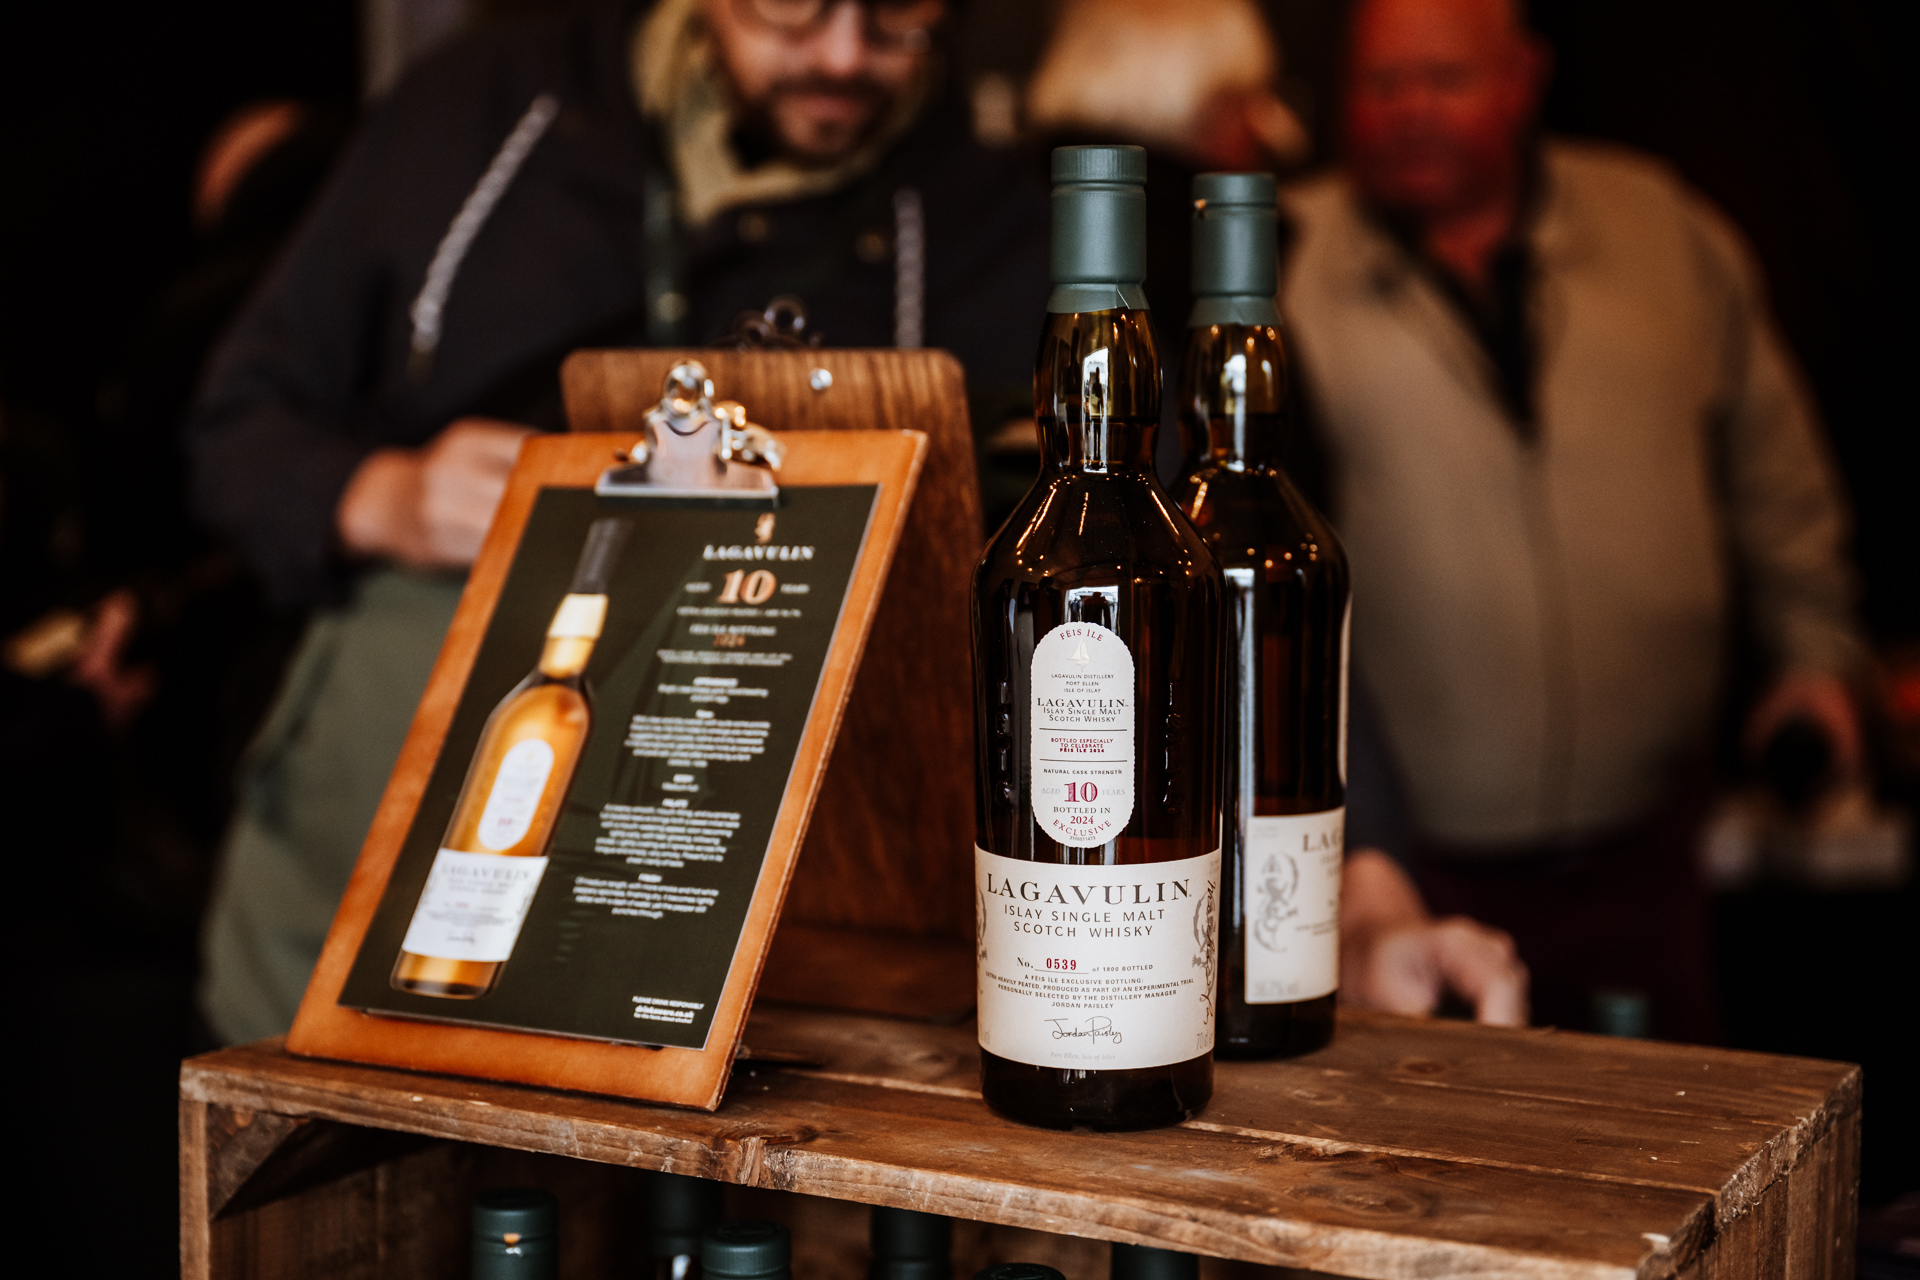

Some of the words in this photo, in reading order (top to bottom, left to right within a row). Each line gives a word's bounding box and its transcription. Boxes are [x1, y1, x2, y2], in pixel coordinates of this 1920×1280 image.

[703, 544, 815, 560] LAGAVULIN
[717, 569, 777, 604] 10
[1060, 628, 1082, 640] FÈIS
[1037, 698, 1126, 708] LAGAVULIN
[1064, 782, 1098, 802] 10
[1053, 819, 1112, 837] EXCLUSIVE
[1070, 816, 1094, 824] 2024
[987, 872, 1190, 906] LAGAVULIN
[1004, 904, 1042, 920] ISLAY
[1052, 911, 1111, 923] SINGLE
[1123, 909, 1165, 922] MALT
[1014, 922, 1076, 937] SCOTCH
[1090, 925, 1154, 938] WHISKY
[1016, 956, 1034, 969] No.
[1046, 957, 1077, 971] 0539
[998, 976, 1016, 985] HEAVILY
[1134, 982, 1180, 992] EXPERIMENTAL
[998, 984, 1033, 996] PERSONALLY
[1035, 992, 1070, 1000] SELECTED
[1144, 990, 1177, 999] MANAGER
